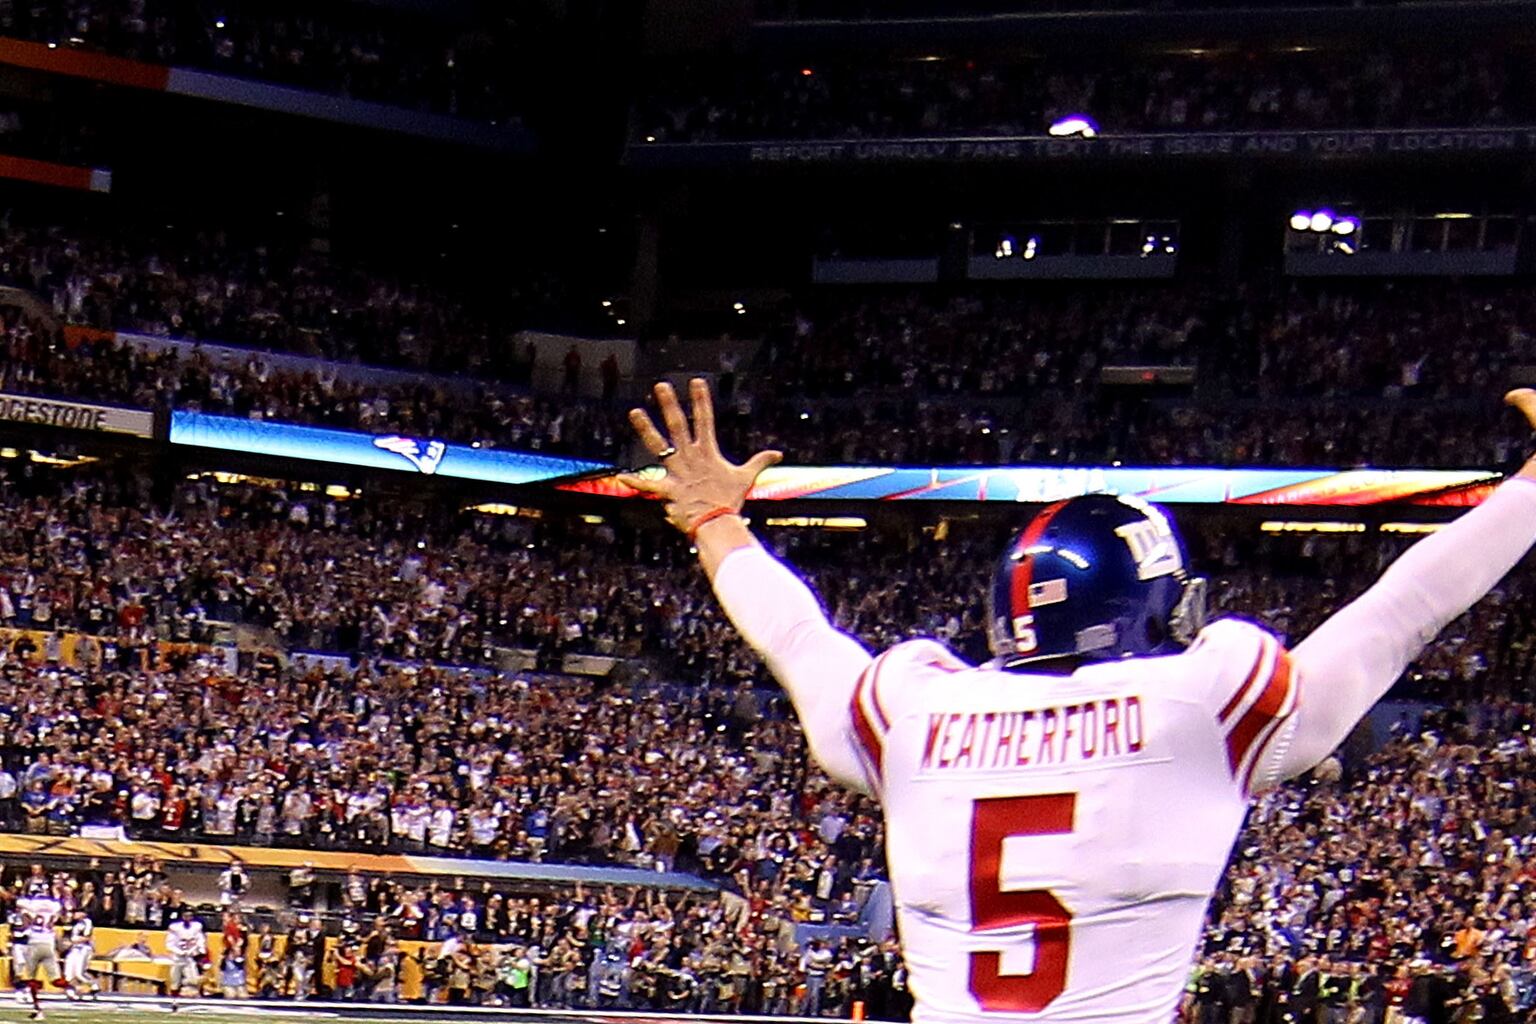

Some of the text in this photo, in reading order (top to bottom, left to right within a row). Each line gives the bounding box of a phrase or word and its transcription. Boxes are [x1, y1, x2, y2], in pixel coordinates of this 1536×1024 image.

[751, 145, 844, 161] REPORT
[960, 142, 1019, 157] FANS
[1108, 139, 1151, 155] THE
[1244, 136, 1297, 152] AND
[1307, 134, 1375, 151] YOUR
[1388, 133, 1515, 150] LOCATION
[1012, 614, 1037, 652] 5
[919, 695, 1144, 770] WEATHERFORD
[968, 792, 1079, 1013] 5
